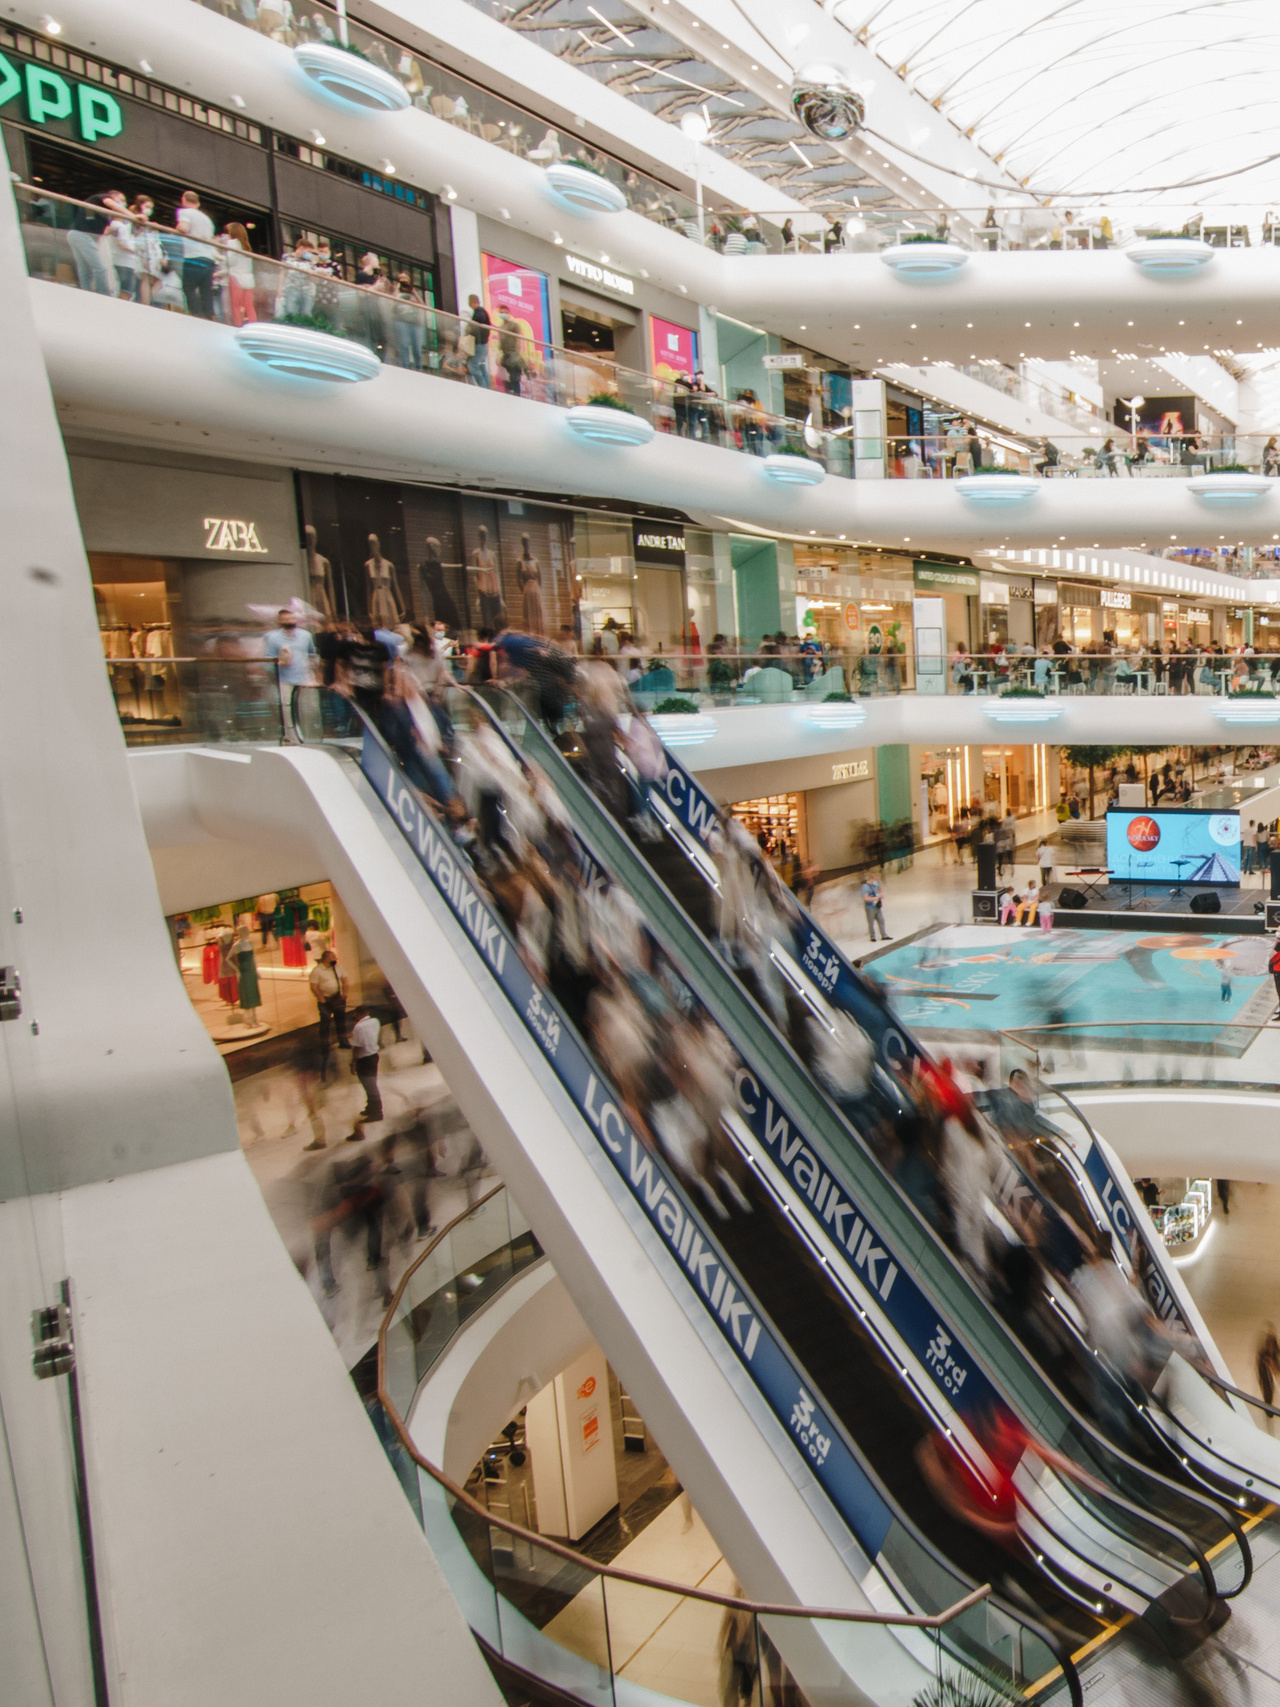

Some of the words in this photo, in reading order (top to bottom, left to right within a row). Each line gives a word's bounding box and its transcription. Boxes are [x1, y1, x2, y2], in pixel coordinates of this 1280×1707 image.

[203, 517, 269, 554] ZARA
[637, 533, 667, 550] ANDRE
[666, 535, 687, 552] TAN
[386, 767, 417, 833] LC
[583, 1072, 627, 1155] LC
[1101, 1177, 1132, 1235] LC
[925, 1347, 960, 1396] floor
[929, 1323, 968, 1388] 3rd
[790, 1413, 825, 1467] floor
[793, 1387, 832, 1458] 3rd
